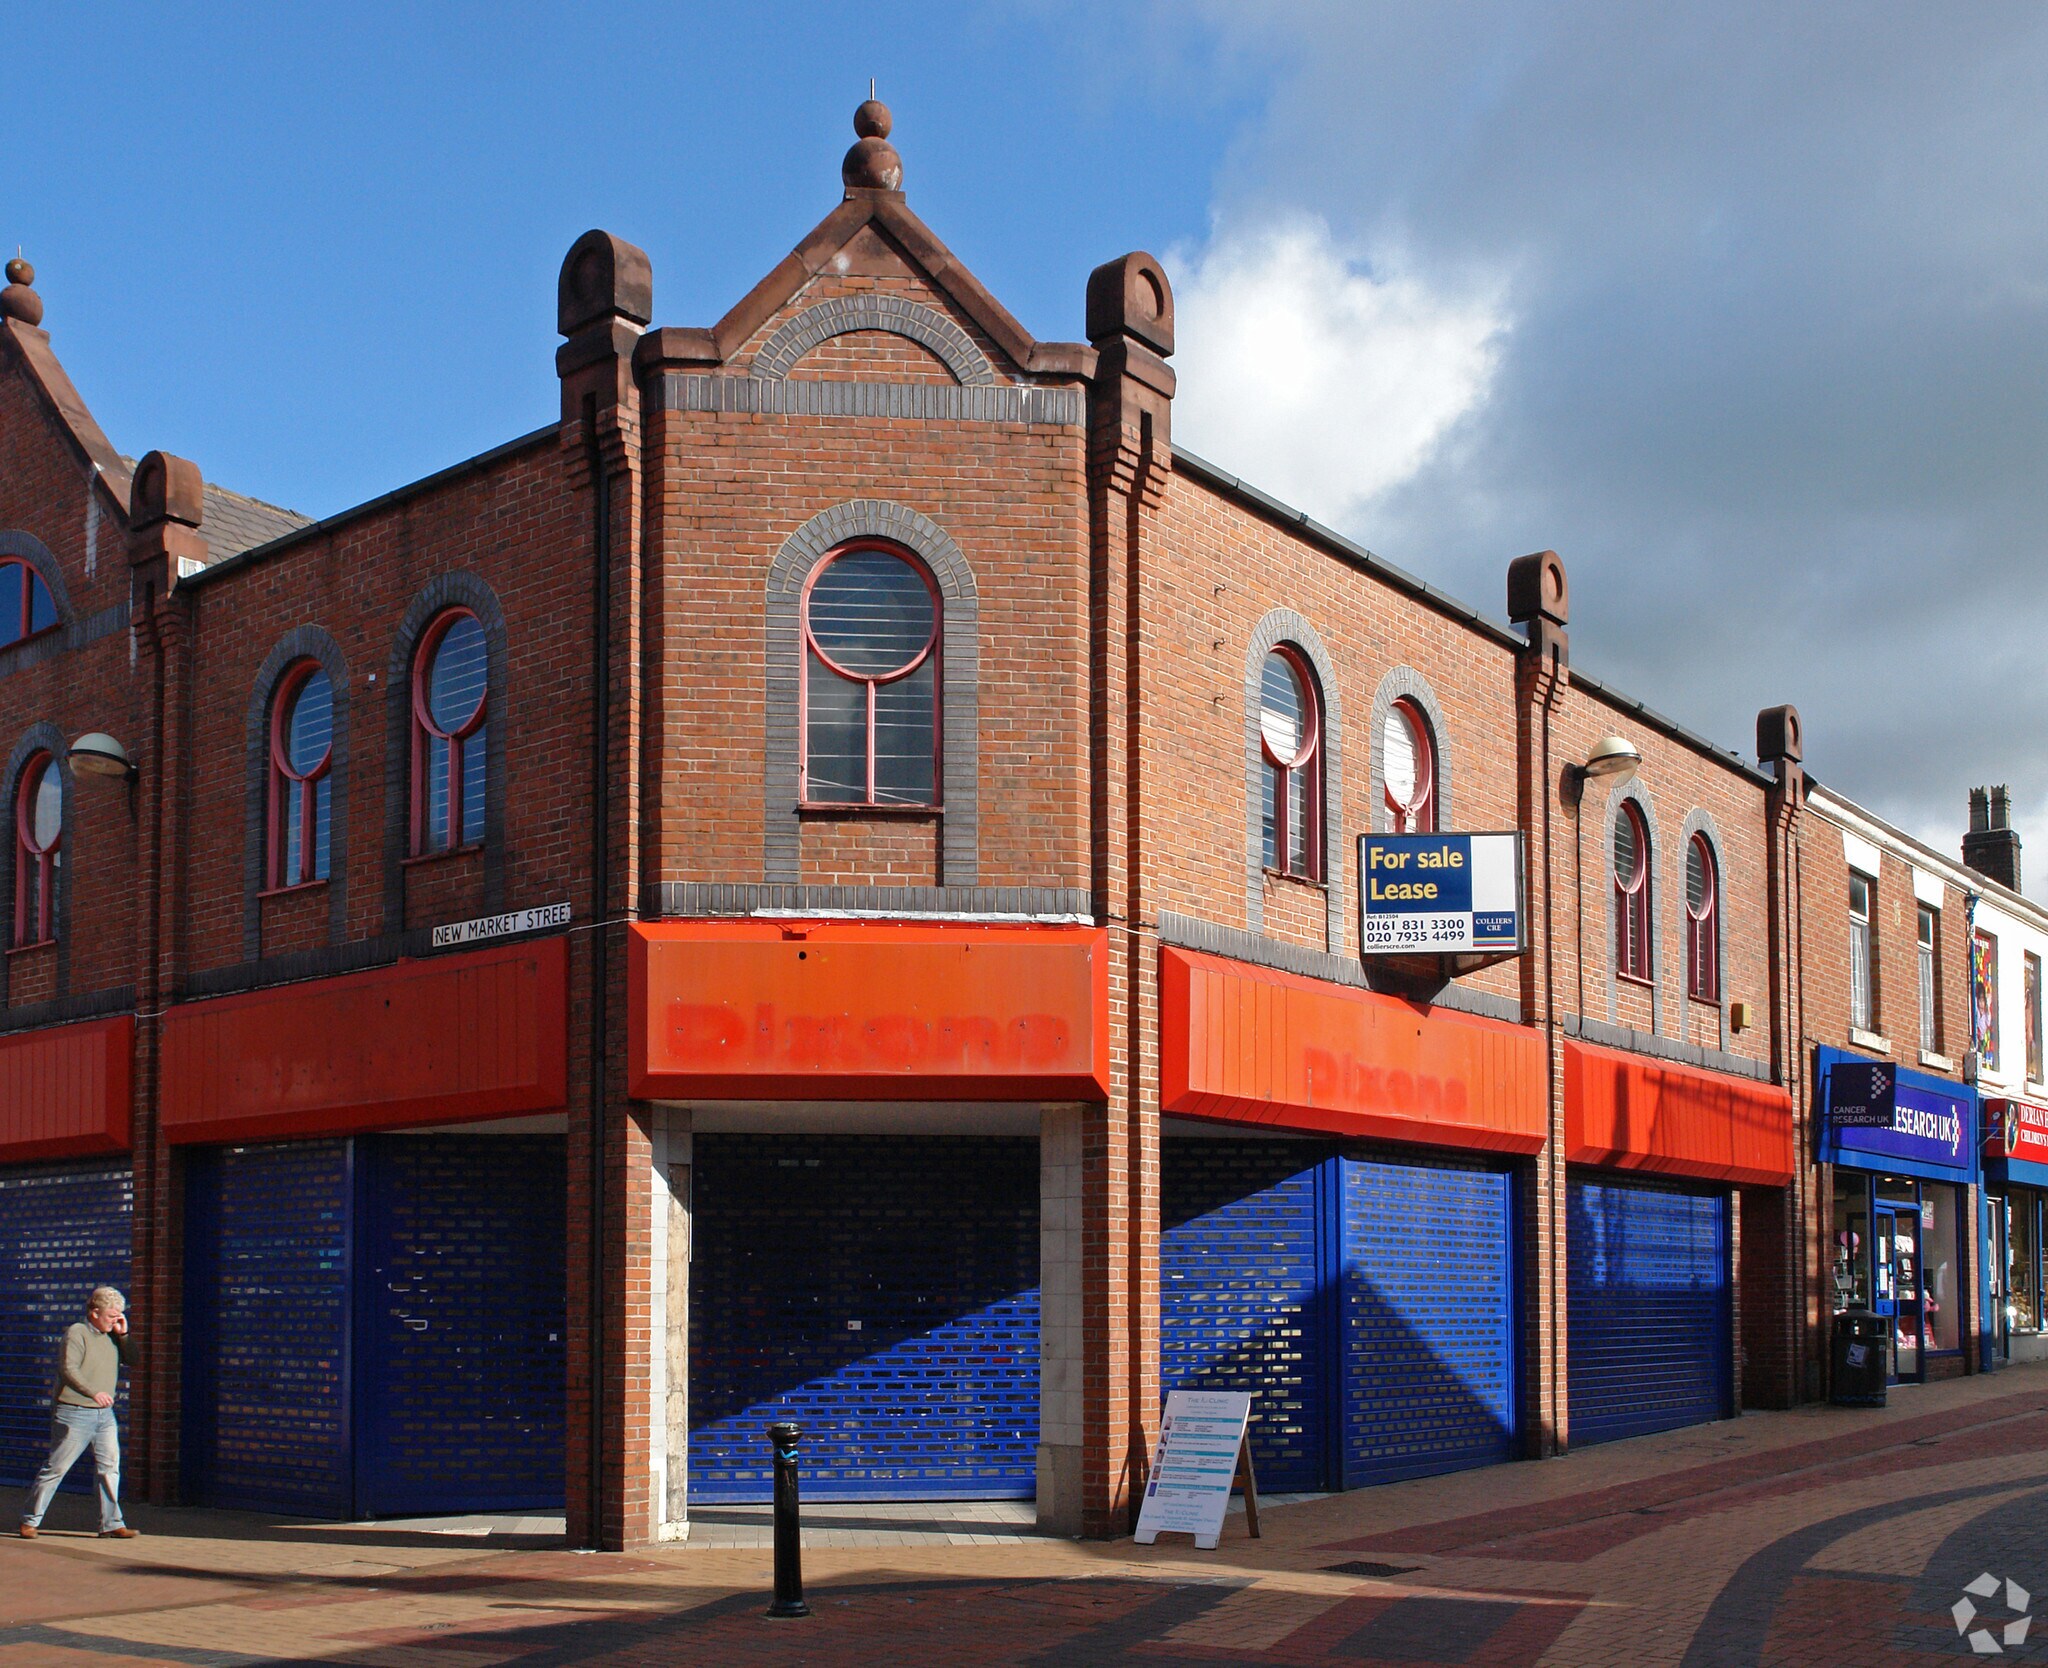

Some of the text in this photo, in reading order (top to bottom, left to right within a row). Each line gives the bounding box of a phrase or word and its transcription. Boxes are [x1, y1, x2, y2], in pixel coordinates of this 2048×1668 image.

[1369, 846, 1464, 870] For sale
[1370, 877, 1438, 900] Lease
[435, 924, 463, 944] NEW
[468, 913, 519, 939] MARKET
[1366, 919, 1465, 931] 0161 831 3300
[1486, 924, 1502, 932] CRE
[1367, 930, 1465, 943] 020 7935 4499
[1833, 1105, 1866, 1114] CANCER
[1832, 1115, 1890, 1124] RESEARCH UK
[1893, 1105, 1951, 1142] ESEARCH UK
